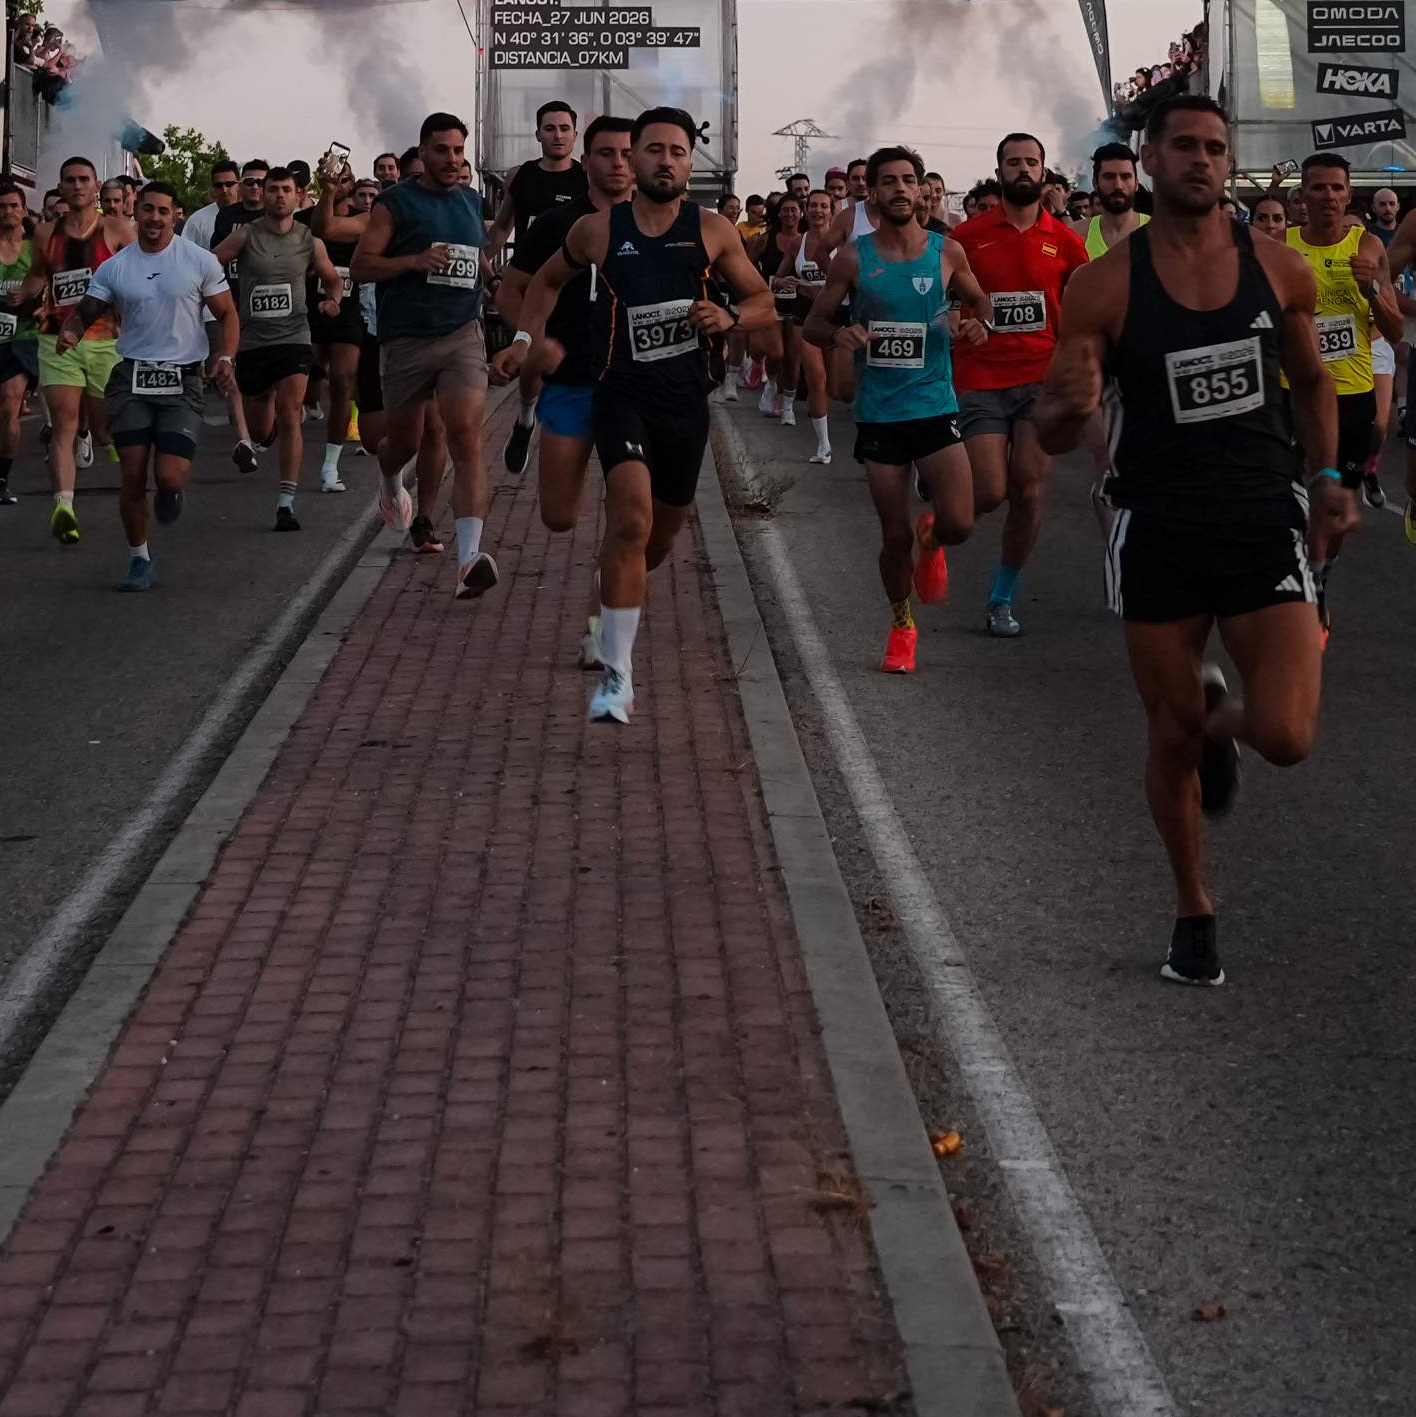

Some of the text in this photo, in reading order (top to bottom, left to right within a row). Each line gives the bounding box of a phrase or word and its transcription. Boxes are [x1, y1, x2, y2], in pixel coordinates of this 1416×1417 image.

[494, 11, 650, 27] FECHA_27 JUN 2026
[1312, 6, 1399, 20] OMODA
[494, 32, 507, 46] N
[1313, 34, 1401, 47] JAECOO
[494, 51, 624, 67] DISTANCIA_07KM
[1322, 68, 1391, 94] HOKA
[1335, 118, 1403, 139] VARTA
[58, 282, 86, 297] 225
[253, 295, 289, 311] 3182
[1001, 306, 1035, 324] 708
[636, 319, 694, 350] 3973
[878, 339, 915, 357] 469
[138, 372, 178, 387] 1482
[1189, 367, 1250, 404] 855
